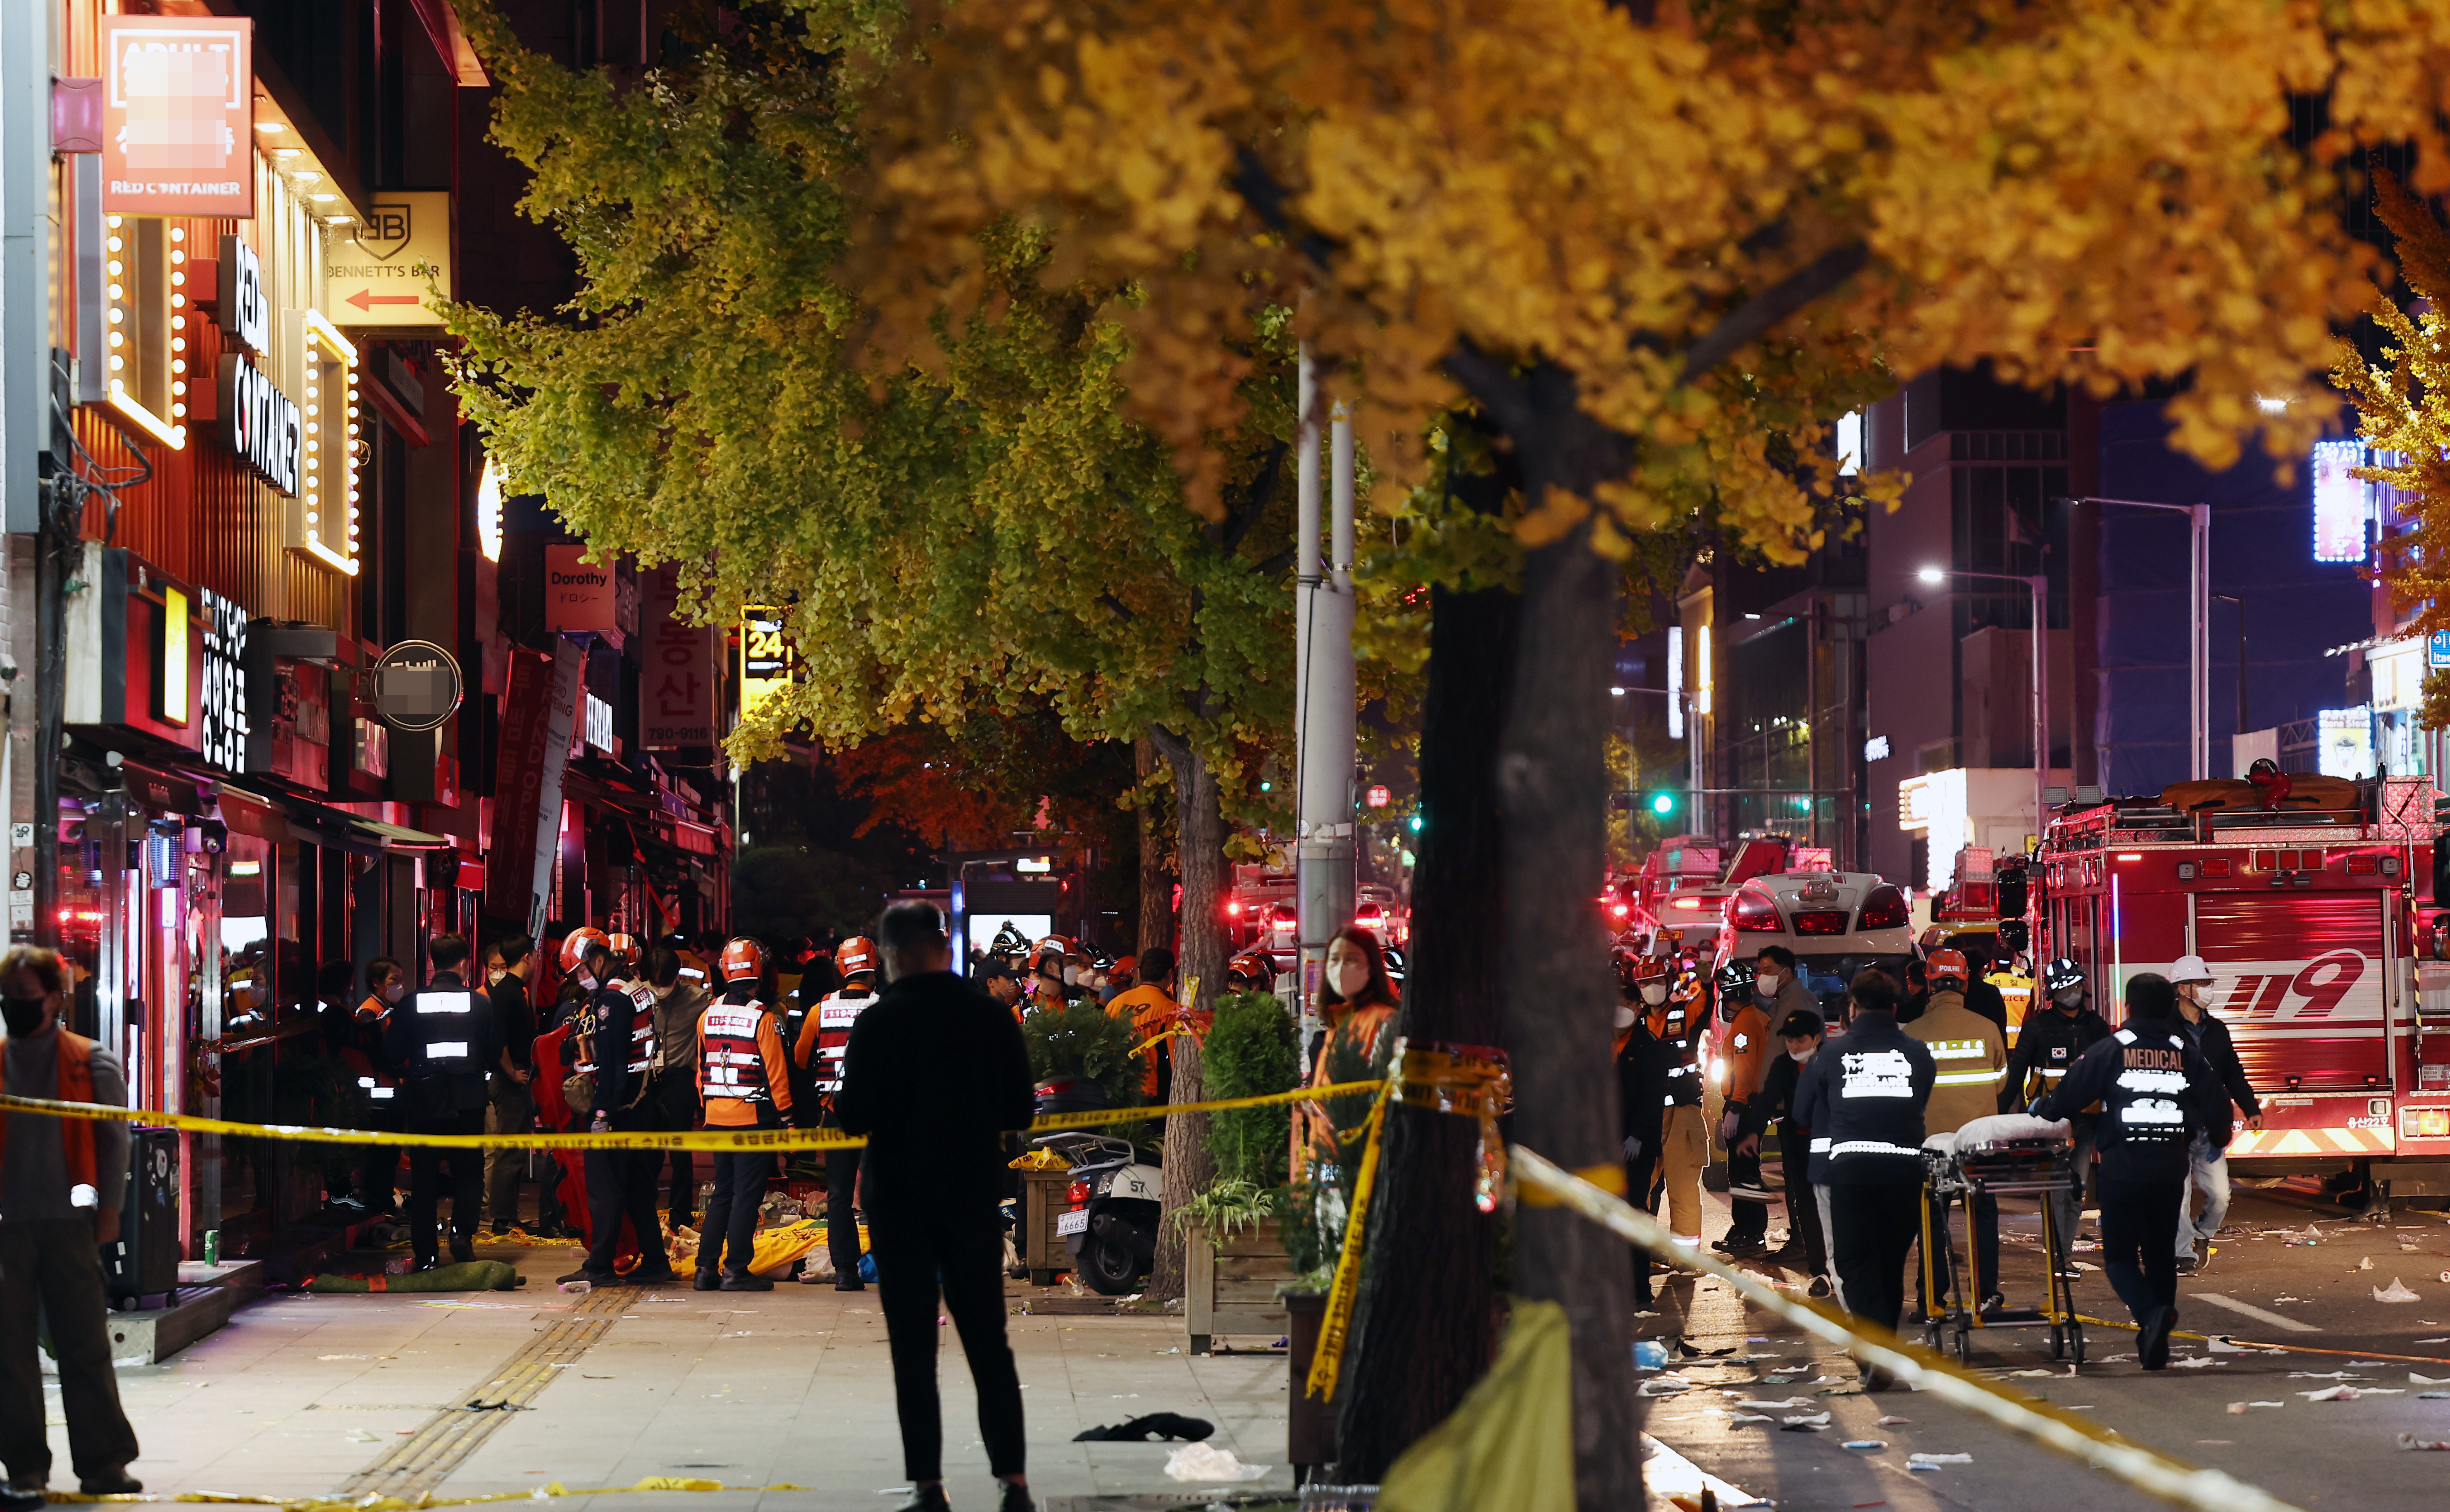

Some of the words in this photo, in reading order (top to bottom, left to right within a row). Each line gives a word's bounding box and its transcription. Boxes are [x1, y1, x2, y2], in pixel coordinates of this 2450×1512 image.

[110, 181, 145, 194] RED
[235, 236, 261, 350] RED
[552, 572, 607, 587] Dorothy
[560, 593, 599, 603] ドロシー
[748, 631, 784, 658] 24
[2433, 633, 2450, 648] 이
[2324, 719, 2344, 728] bone
[649, 727, 708, 740] 790-9116
[1370, 798, 1387, 806] STOP
[2223, 952, 2364, 1018] 119
[2123, 1048, 2184, 1070] MEDICAL
[1845, 1076, 1909, 1087] AMBULANCE
[2347, 1117, 2390, 1129] 용산22호
[1131, 1181, 1145, 1193] 57
[1065, 1219, 1085, 1231] 6665
